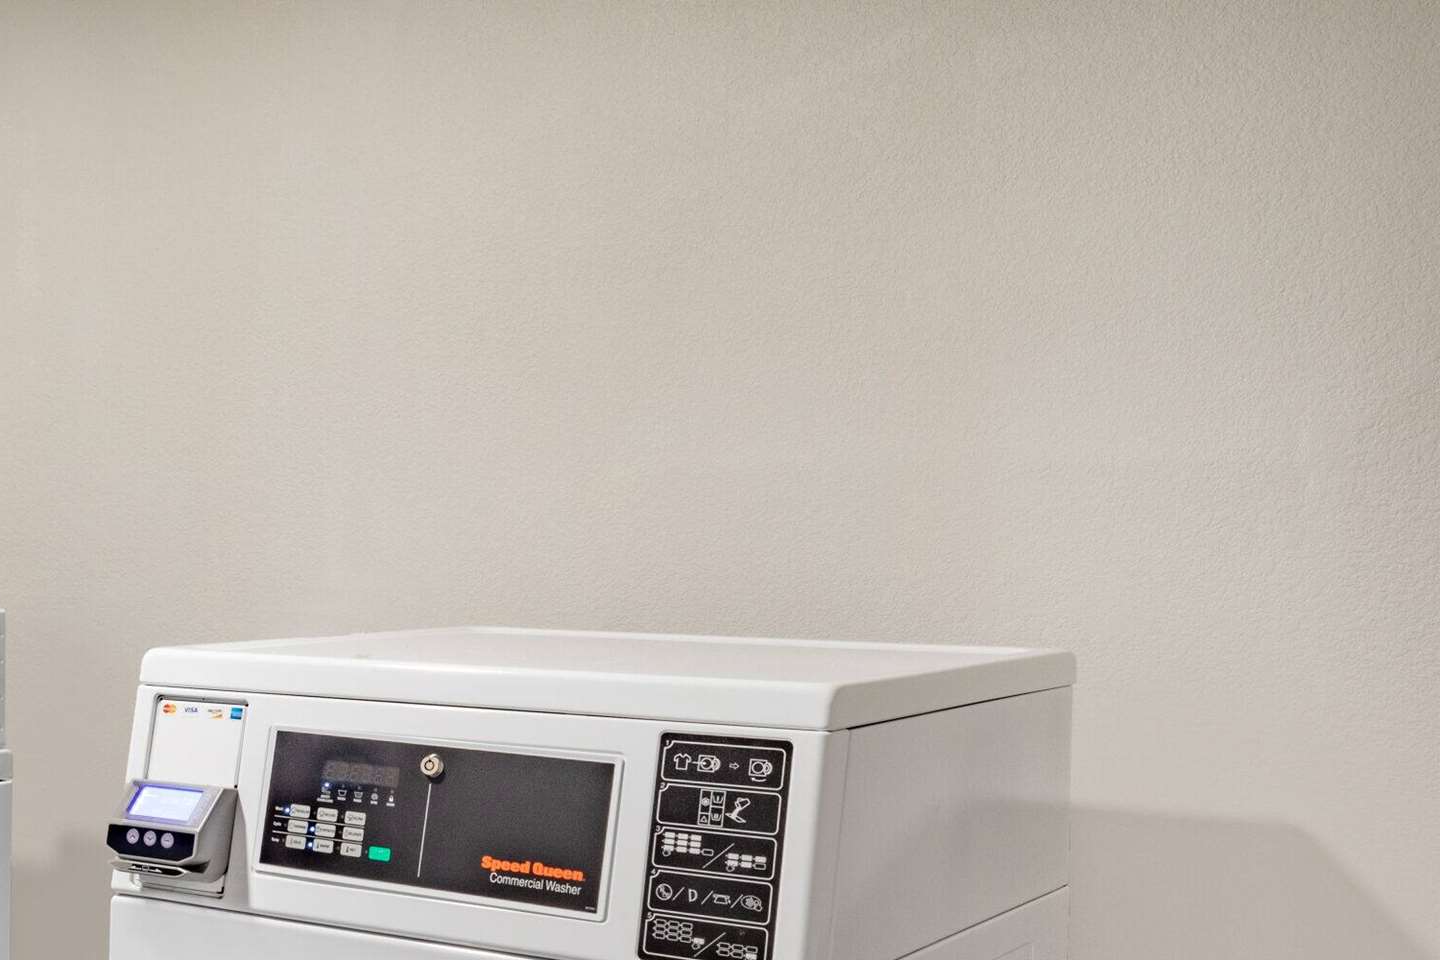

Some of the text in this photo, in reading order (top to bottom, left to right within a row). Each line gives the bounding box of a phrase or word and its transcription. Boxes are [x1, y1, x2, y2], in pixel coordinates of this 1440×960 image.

[481, 855, 584, 881] Speed Queen
[489, 872, 582, 895] Commercial Washer
